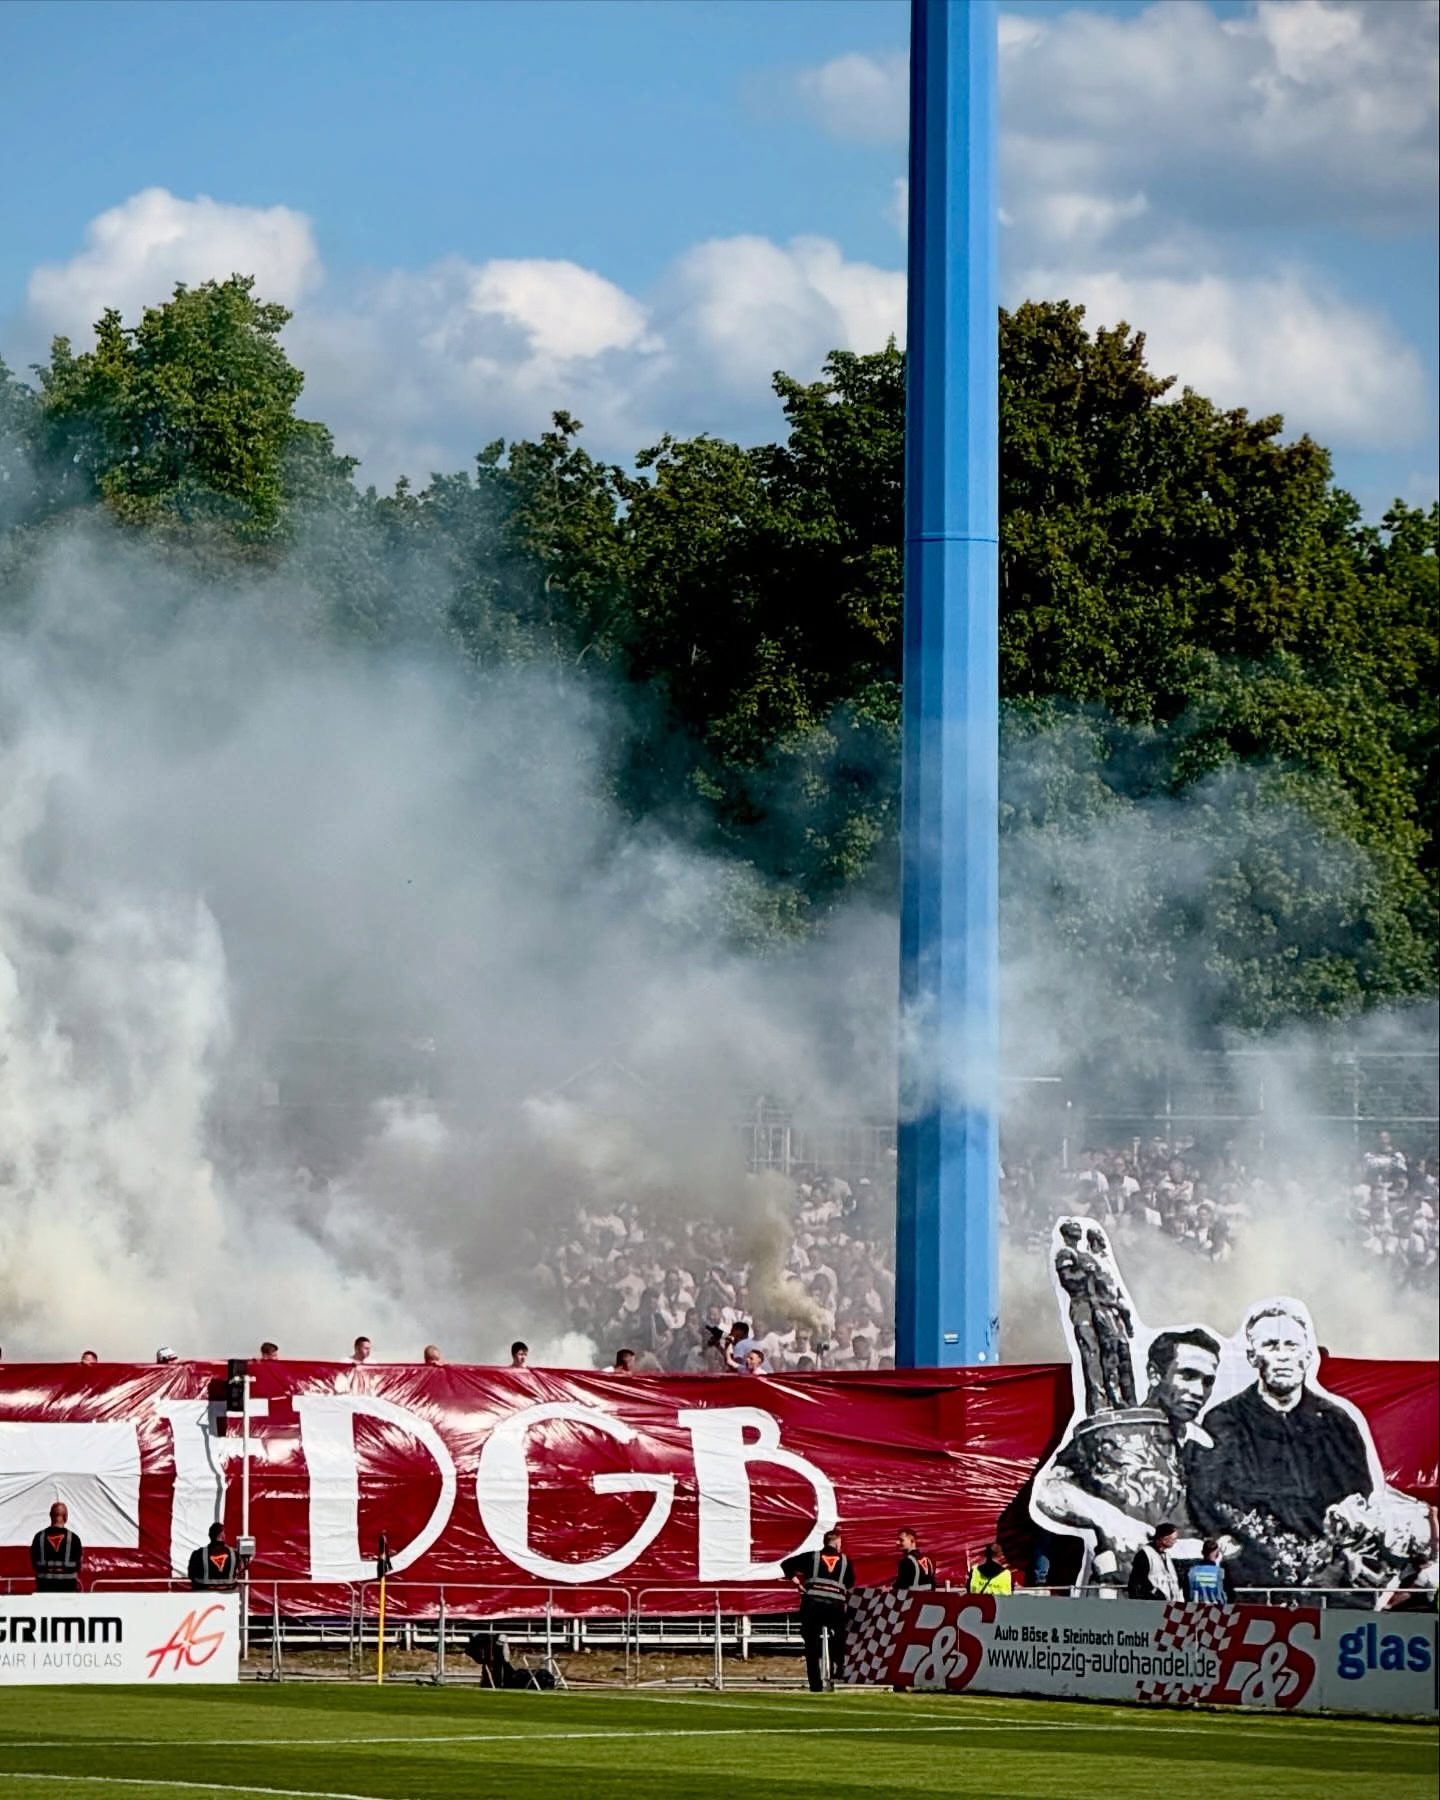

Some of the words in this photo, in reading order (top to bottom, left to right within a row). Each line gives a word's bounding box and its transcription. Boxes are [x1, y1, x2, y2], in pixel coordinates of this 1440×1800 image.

[152, 1394, 840, 1584] FDGB
[0, 1616, 123, 1643] RIMM
[994, 1625, 1019, 1641] Auto
[1022, 1626, 1048, 1643] Böse
[1051, 1627, 1059, 1643] &
[1063, 1628, 1114, 1646] Steinbach
[1117, 1631, 1149, 1648] GmbH
[0, 1653, 26, 1668] AIR
[43, 1653, 123, 1668] AUTOGLAS
[987, 1645, 1217, 1679] www.leipzig-autohandel.de
[1337, 1622, 1432, 1680] glas
